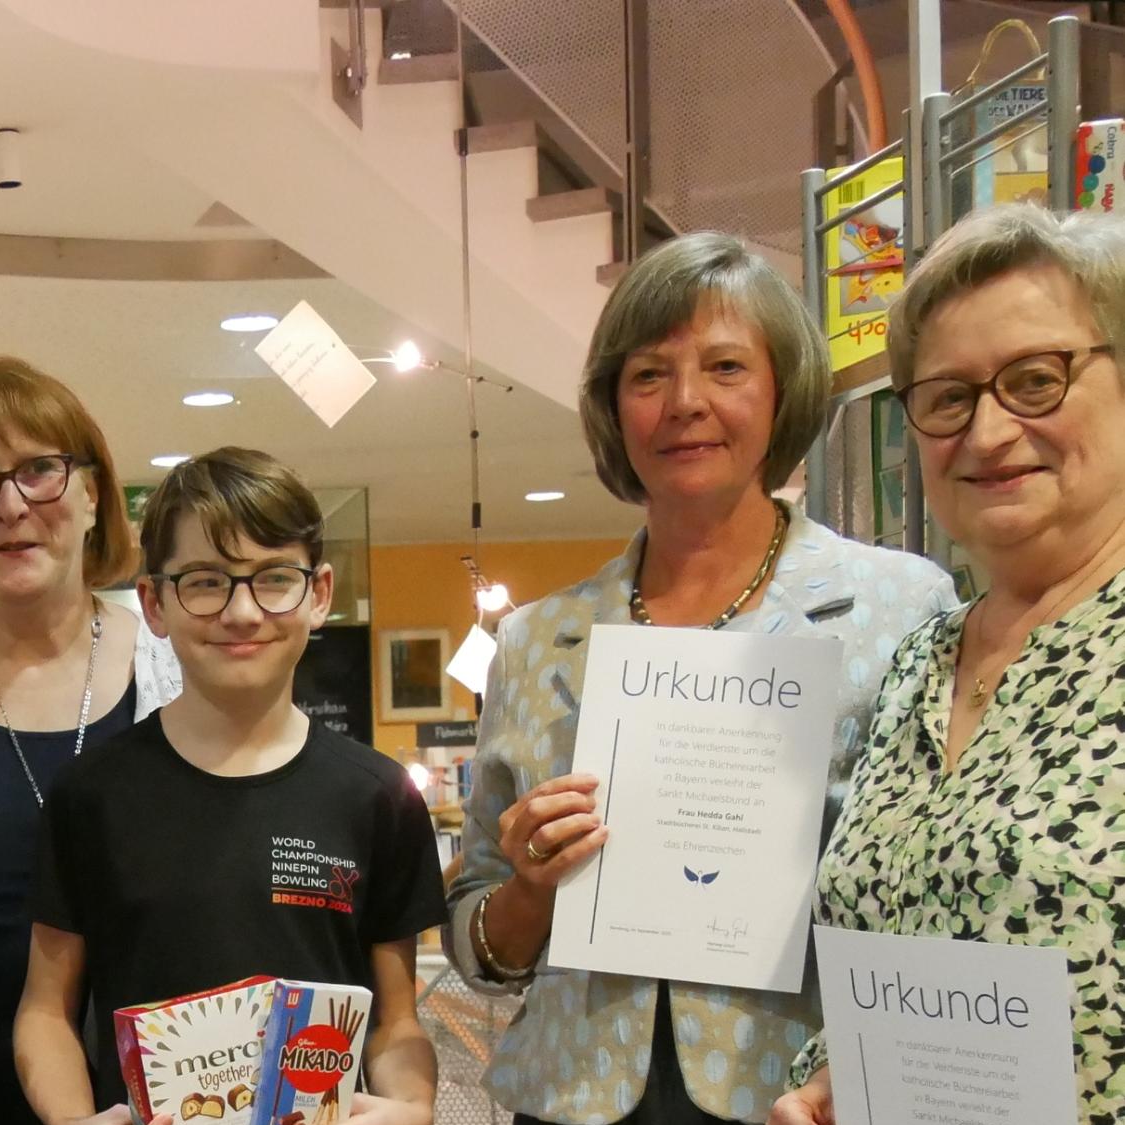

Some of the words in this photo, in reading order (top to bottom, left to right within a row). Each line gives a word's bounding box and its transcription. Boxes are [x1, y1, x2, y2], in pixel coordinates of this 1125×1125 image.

[1011, 87, 1045, 101] TIERE
[1106, 126, 1117, 159] Cobra
[621, 659, 802, 708] Urkunde
[719, 727, 782, 743] Anerkennung
[693, 742, 739, 754] Verdienste
[743, 747, 758, 755] um
[654, 755, 706, 768] katholische
[675, 773, 707, 785] Bayern
[746, 780, 762, 790] der
[657, 787, 683, 799] Sankt
[685, 791, 750, 806] Michaelsbund
[678, 808, 695, 817] Frau
[697, 810, 723, 820] Hedda
[725, 812, 744, 822] Gahl
[271, 836, 316, 850] WORLD
[663, 840, 681, 849] das
[683, 841, 746, 856] Ehrenzeichen
[271, 849, 356, 868] CHAMPIONSHIP
[272, 862, 320, 875] NINEPIN
[272, 874, 328, 889] BOWLING
[271, 893, 326, 908] BREZNO
[287, 992, 299, 1006] LU
[850, 967, 1029, 1028] Urkunde
[278, 1044, 355, 1073] MIKADO
[197, 1063, 253, 1092] together
[933, 1061, 980, 1077] Verdienste
[1001, 1071, 1016, 1082] die
[901, 1074, 951, 1090] katholische
[924, 1094, 956, 1108] Bayern
